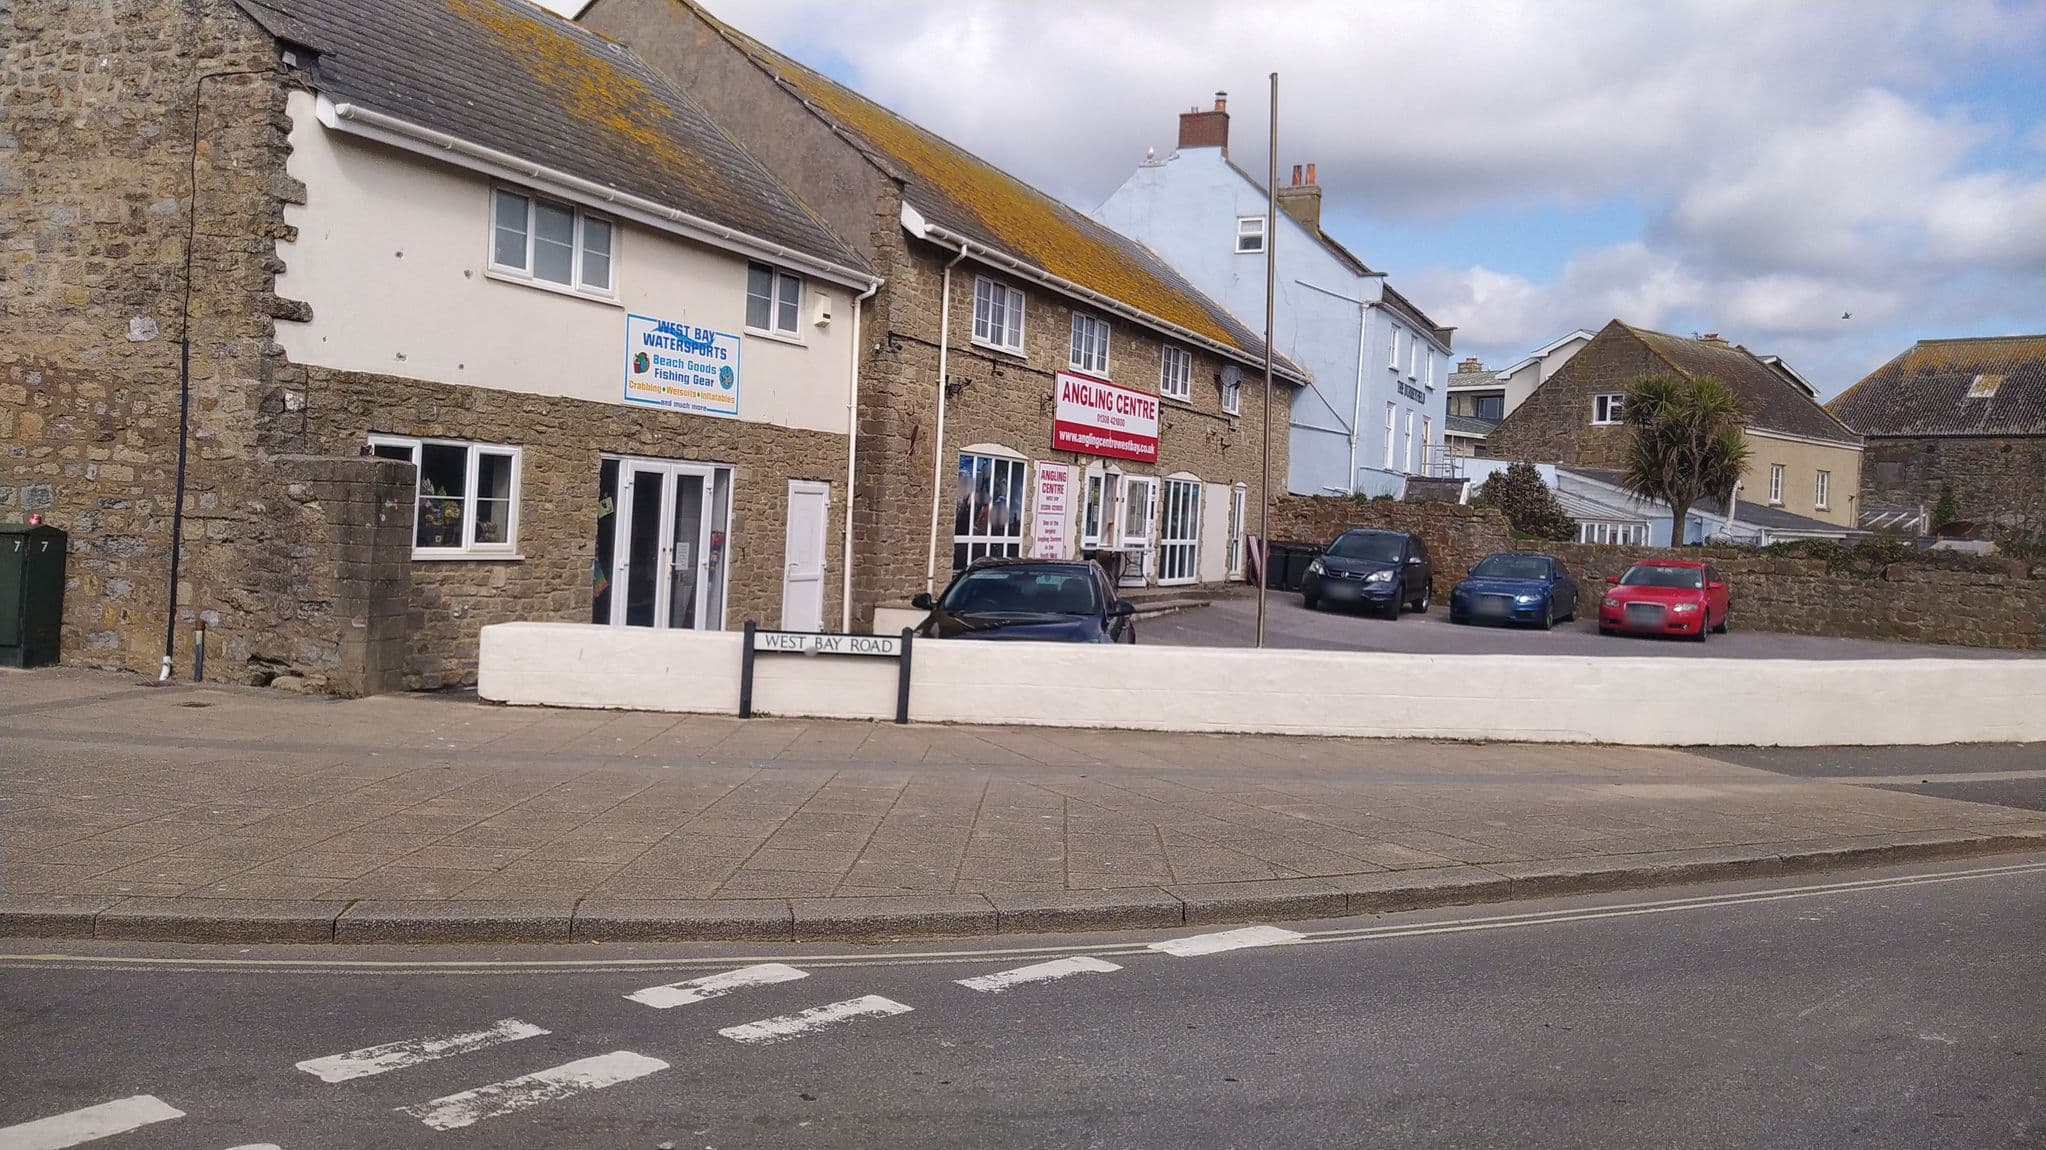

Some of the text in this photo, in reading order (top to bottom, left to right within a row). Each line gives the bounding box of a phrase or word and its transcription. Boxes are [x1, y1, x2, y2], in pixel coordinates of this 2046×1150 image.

[657, 320, 716, 343] WEST BAY
[643, 332, 727, 360] WATERSPORTS
[653, 354, 717, 375] Beach Goods
[654, 367, 715, 388] Fishing Gear
[629, 380, 735, 404] Crabbing Wetsuits Inflatables
[1062, 381, 1155, 420] ANGLING CENTRE
[660, 399, 708, 412] and much more
[1041, 469, 1067, 482] ANGLING
[1042, 482, 1065, 494] CENTRE
[14, 540, 21, 553] 7
[41, 541, 49, 553] 7
[765, 634, 893, 653] WEST BAY ROAD
